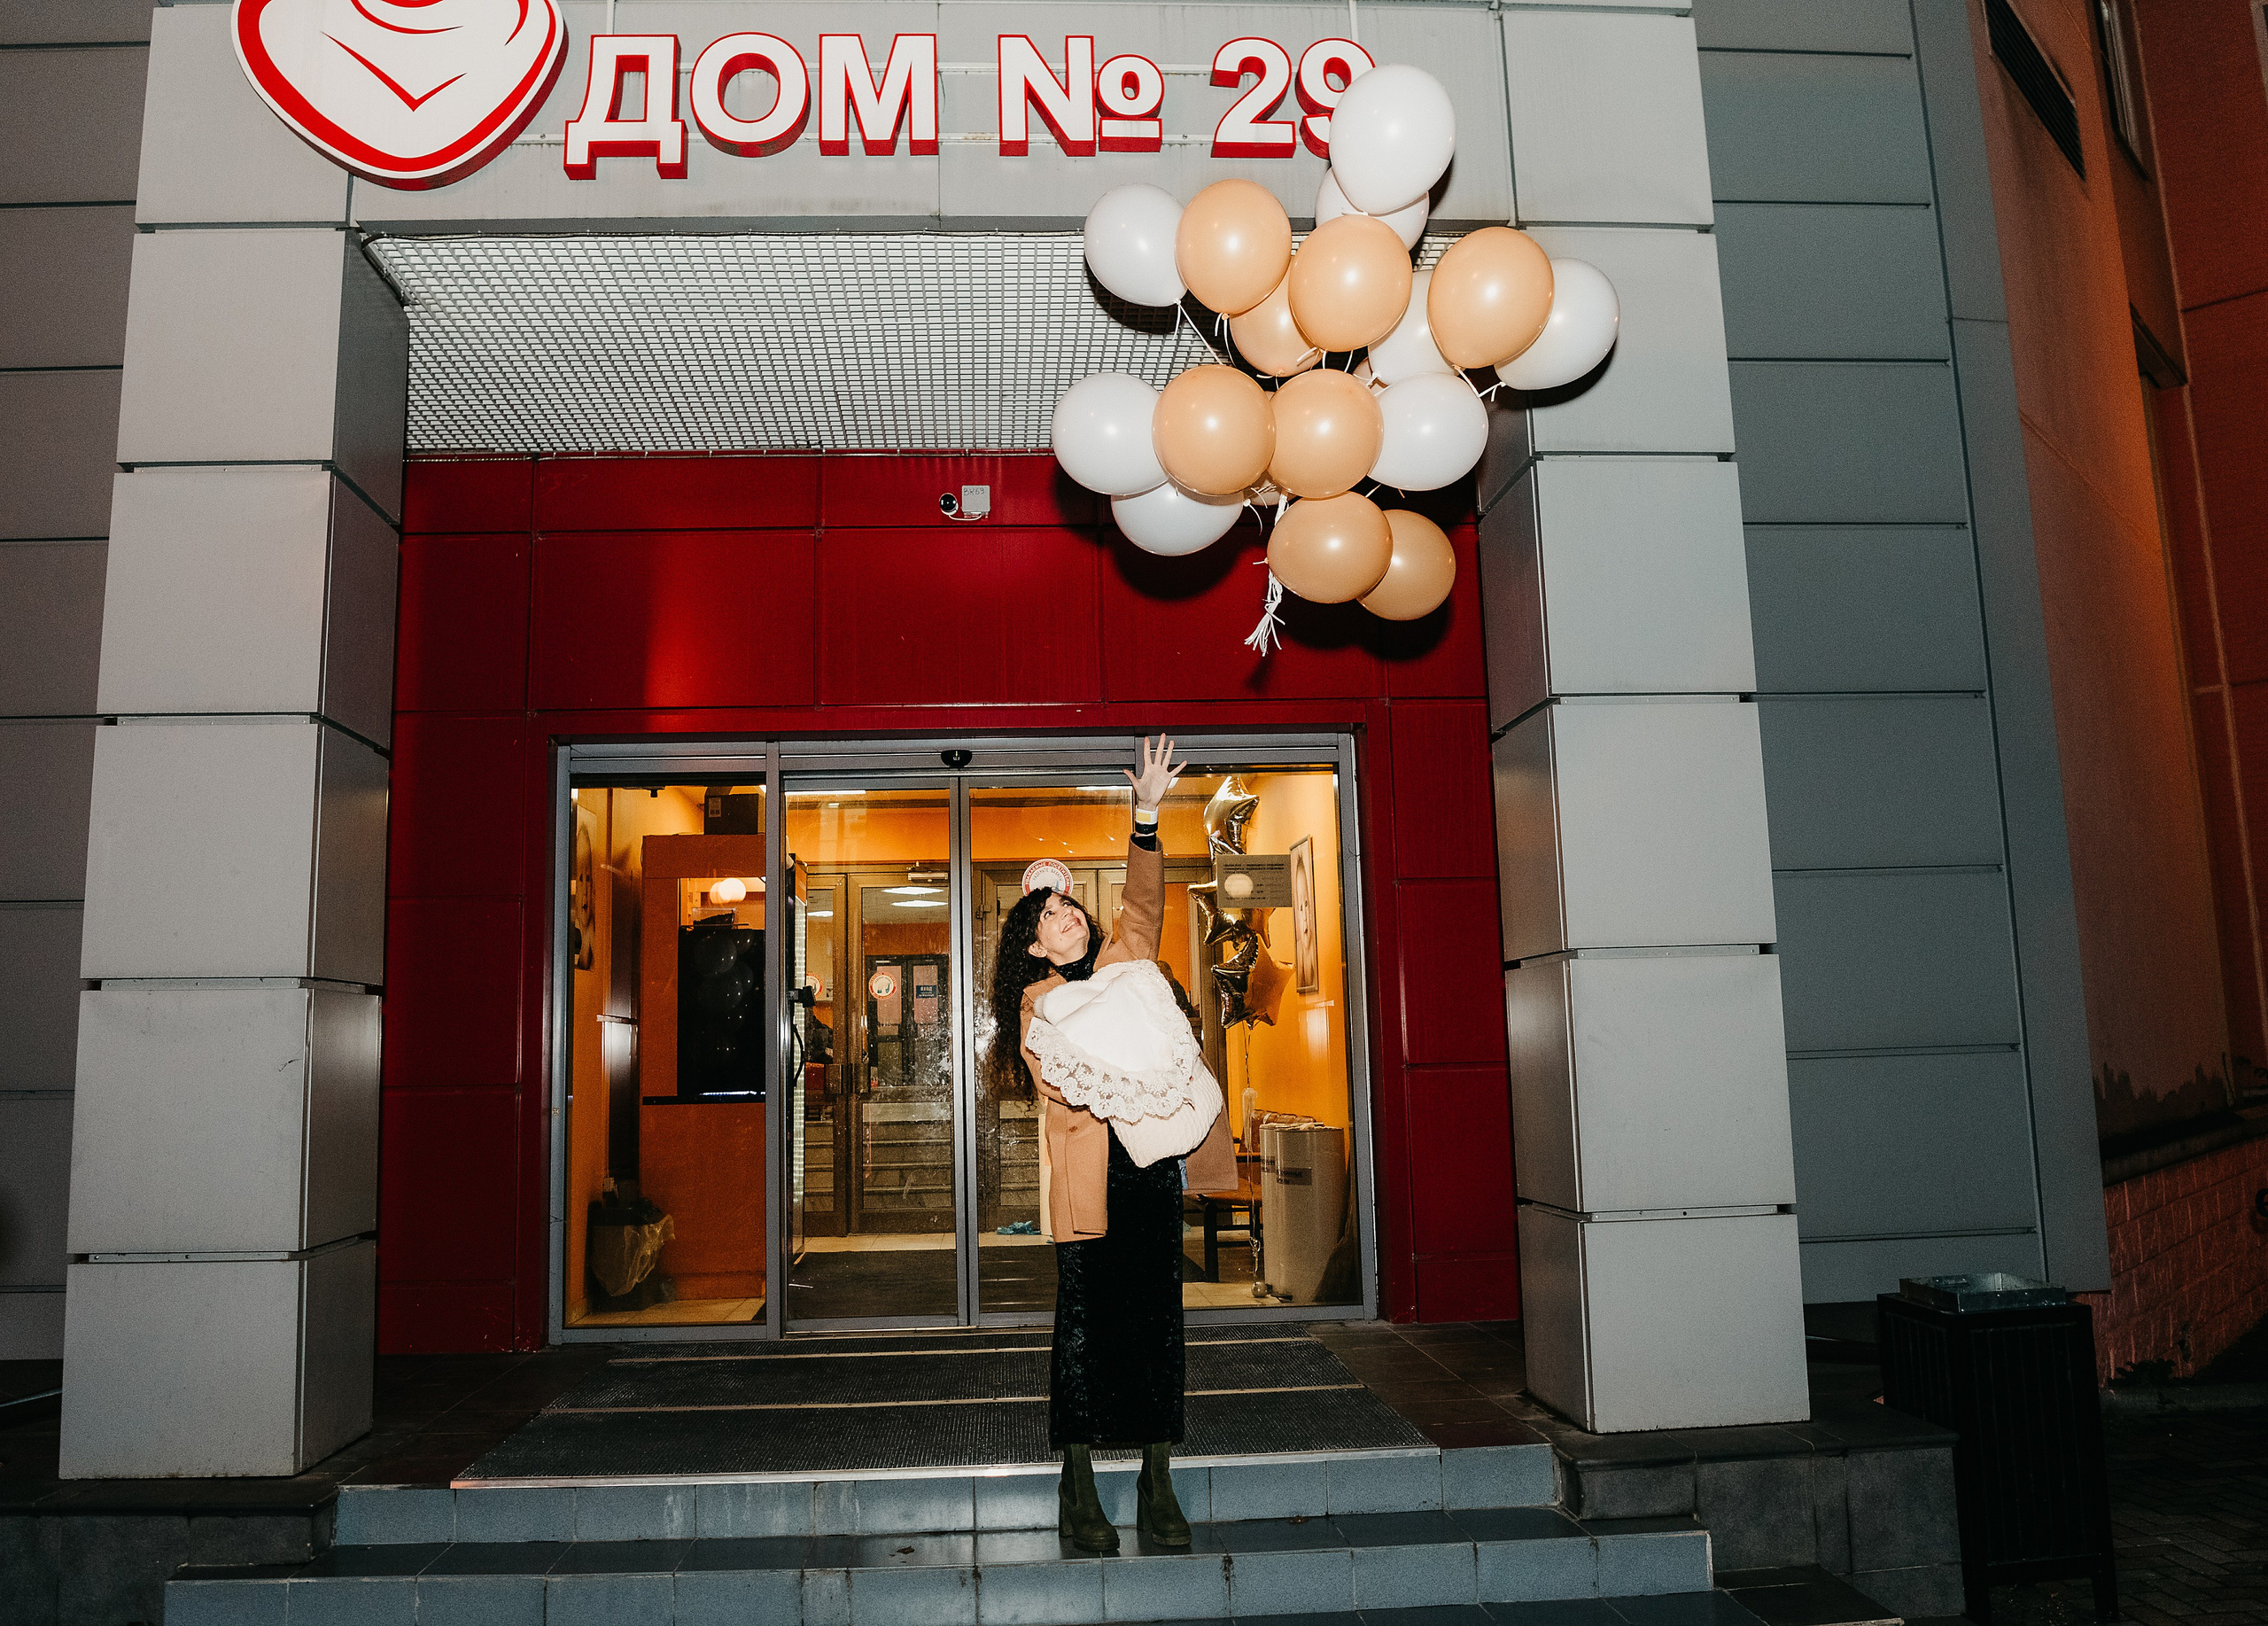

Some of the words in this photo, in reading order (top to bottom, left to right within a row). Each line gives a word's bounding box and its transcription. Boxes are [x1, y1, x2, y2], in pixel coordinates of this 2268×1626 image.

[563, 31, 939, 180] ДОМ
[997, 34, 1164, 158] №
[1208, 36, 1376, 159] 29
